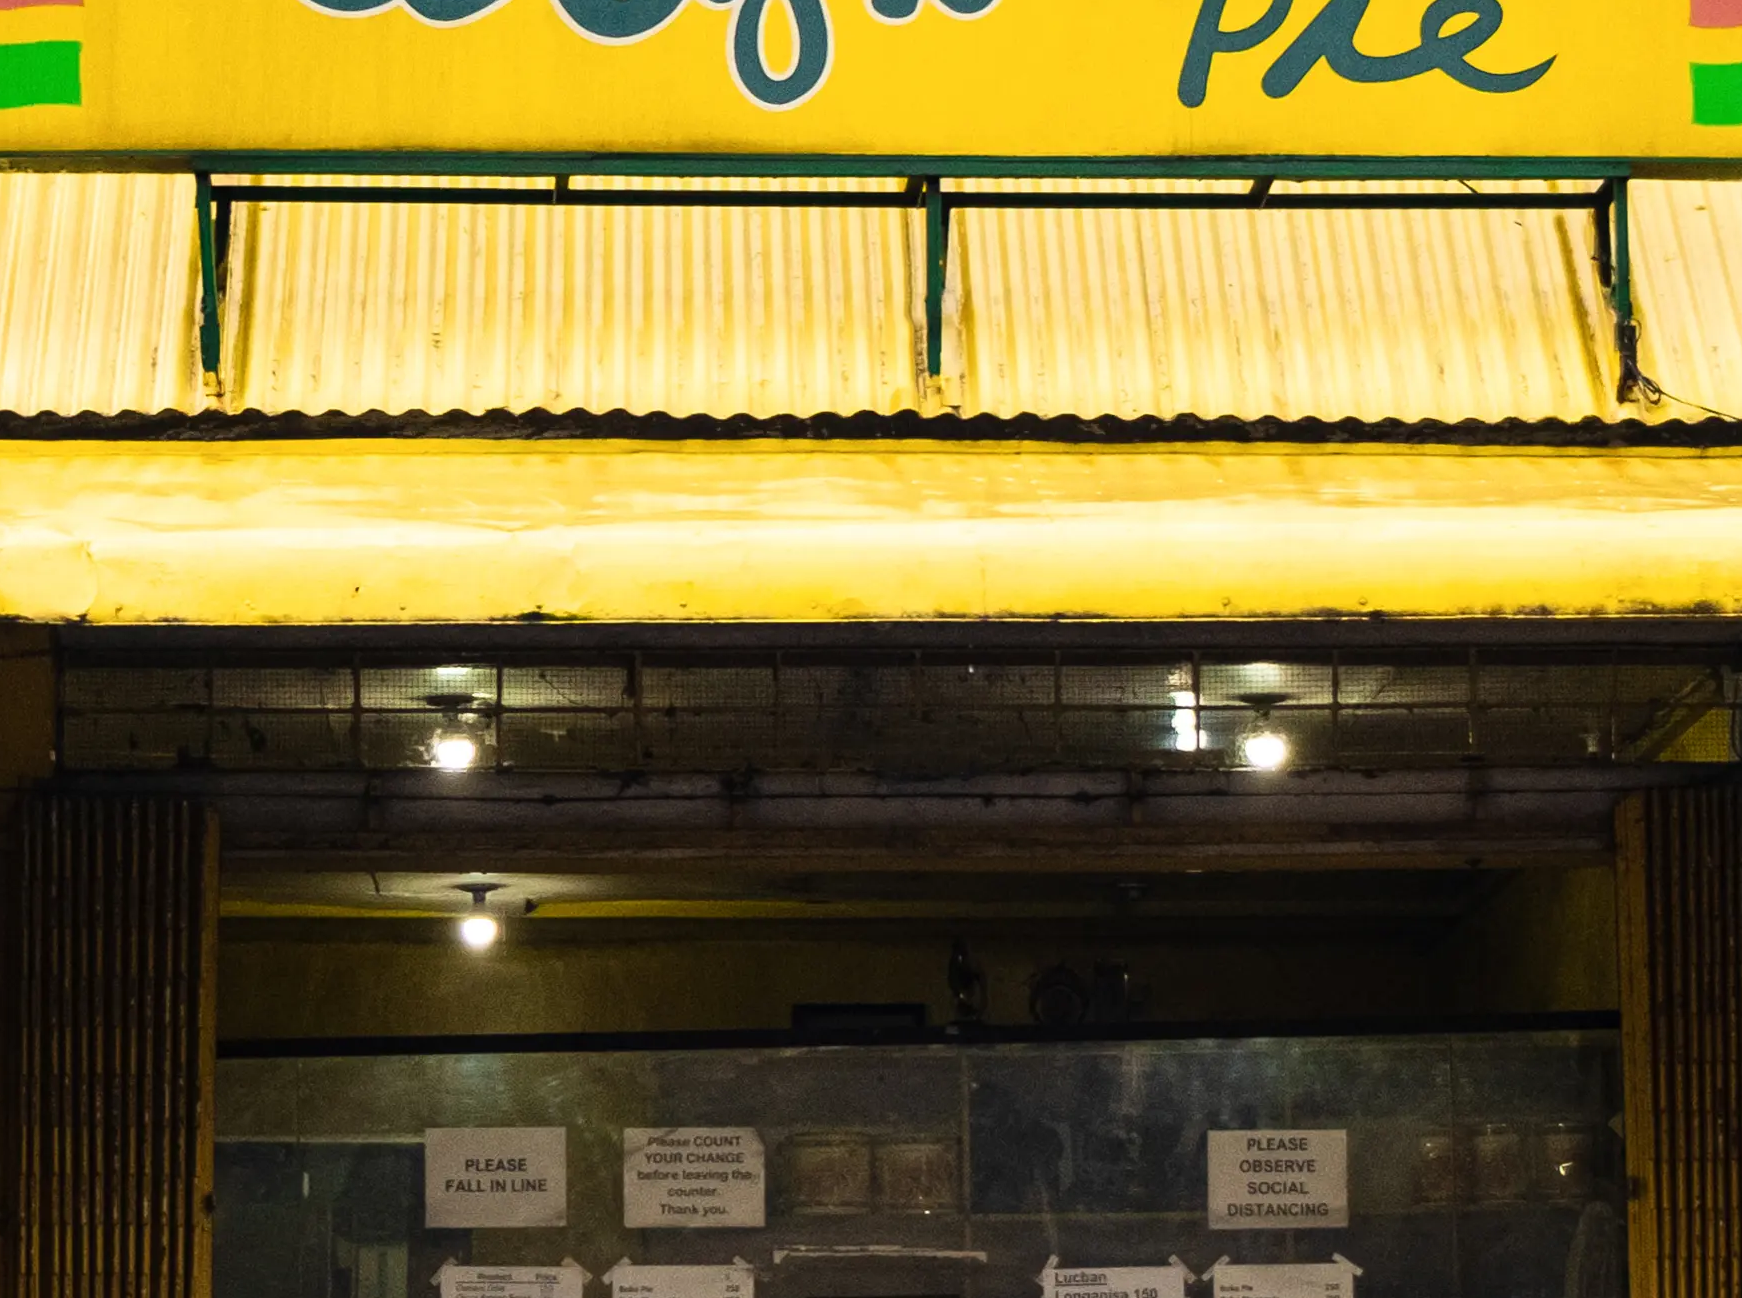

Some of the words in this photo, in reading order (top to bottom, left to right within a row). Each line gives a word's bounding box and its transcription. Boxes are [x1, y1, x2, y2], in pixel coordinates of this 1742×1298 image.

[647, 1136, 691, 1147] Please
[694, 1136, 741, 1147] COUNT
[1247, 1137, 1308, 1151] PLEASE
[465, 1158, 527, 1172] PLEASE
[645, 1153, 682, 1164] YOUR
[687, 1153, 744, 1164] CHANGE
[1239, 1159, 1316, 1173] OBSERVE
[637, 1170, 679, 1181] before
[683, 1170, 728, 1181] leaving
[732, 1170, 752, 1181] the
[445, 1179, 485, 1192] FALL
[490, 1179, 506, 1192] IN
[511, 1179, 547, 1192] LINE
[1247, 1181, 1309, 1195] SOCIAL
[660, 1204, 699, 1216] Thank
[1227, 1203, 1329, 1217] DISTANCING
[1055, 1272, 1107, 1284] Lucban
